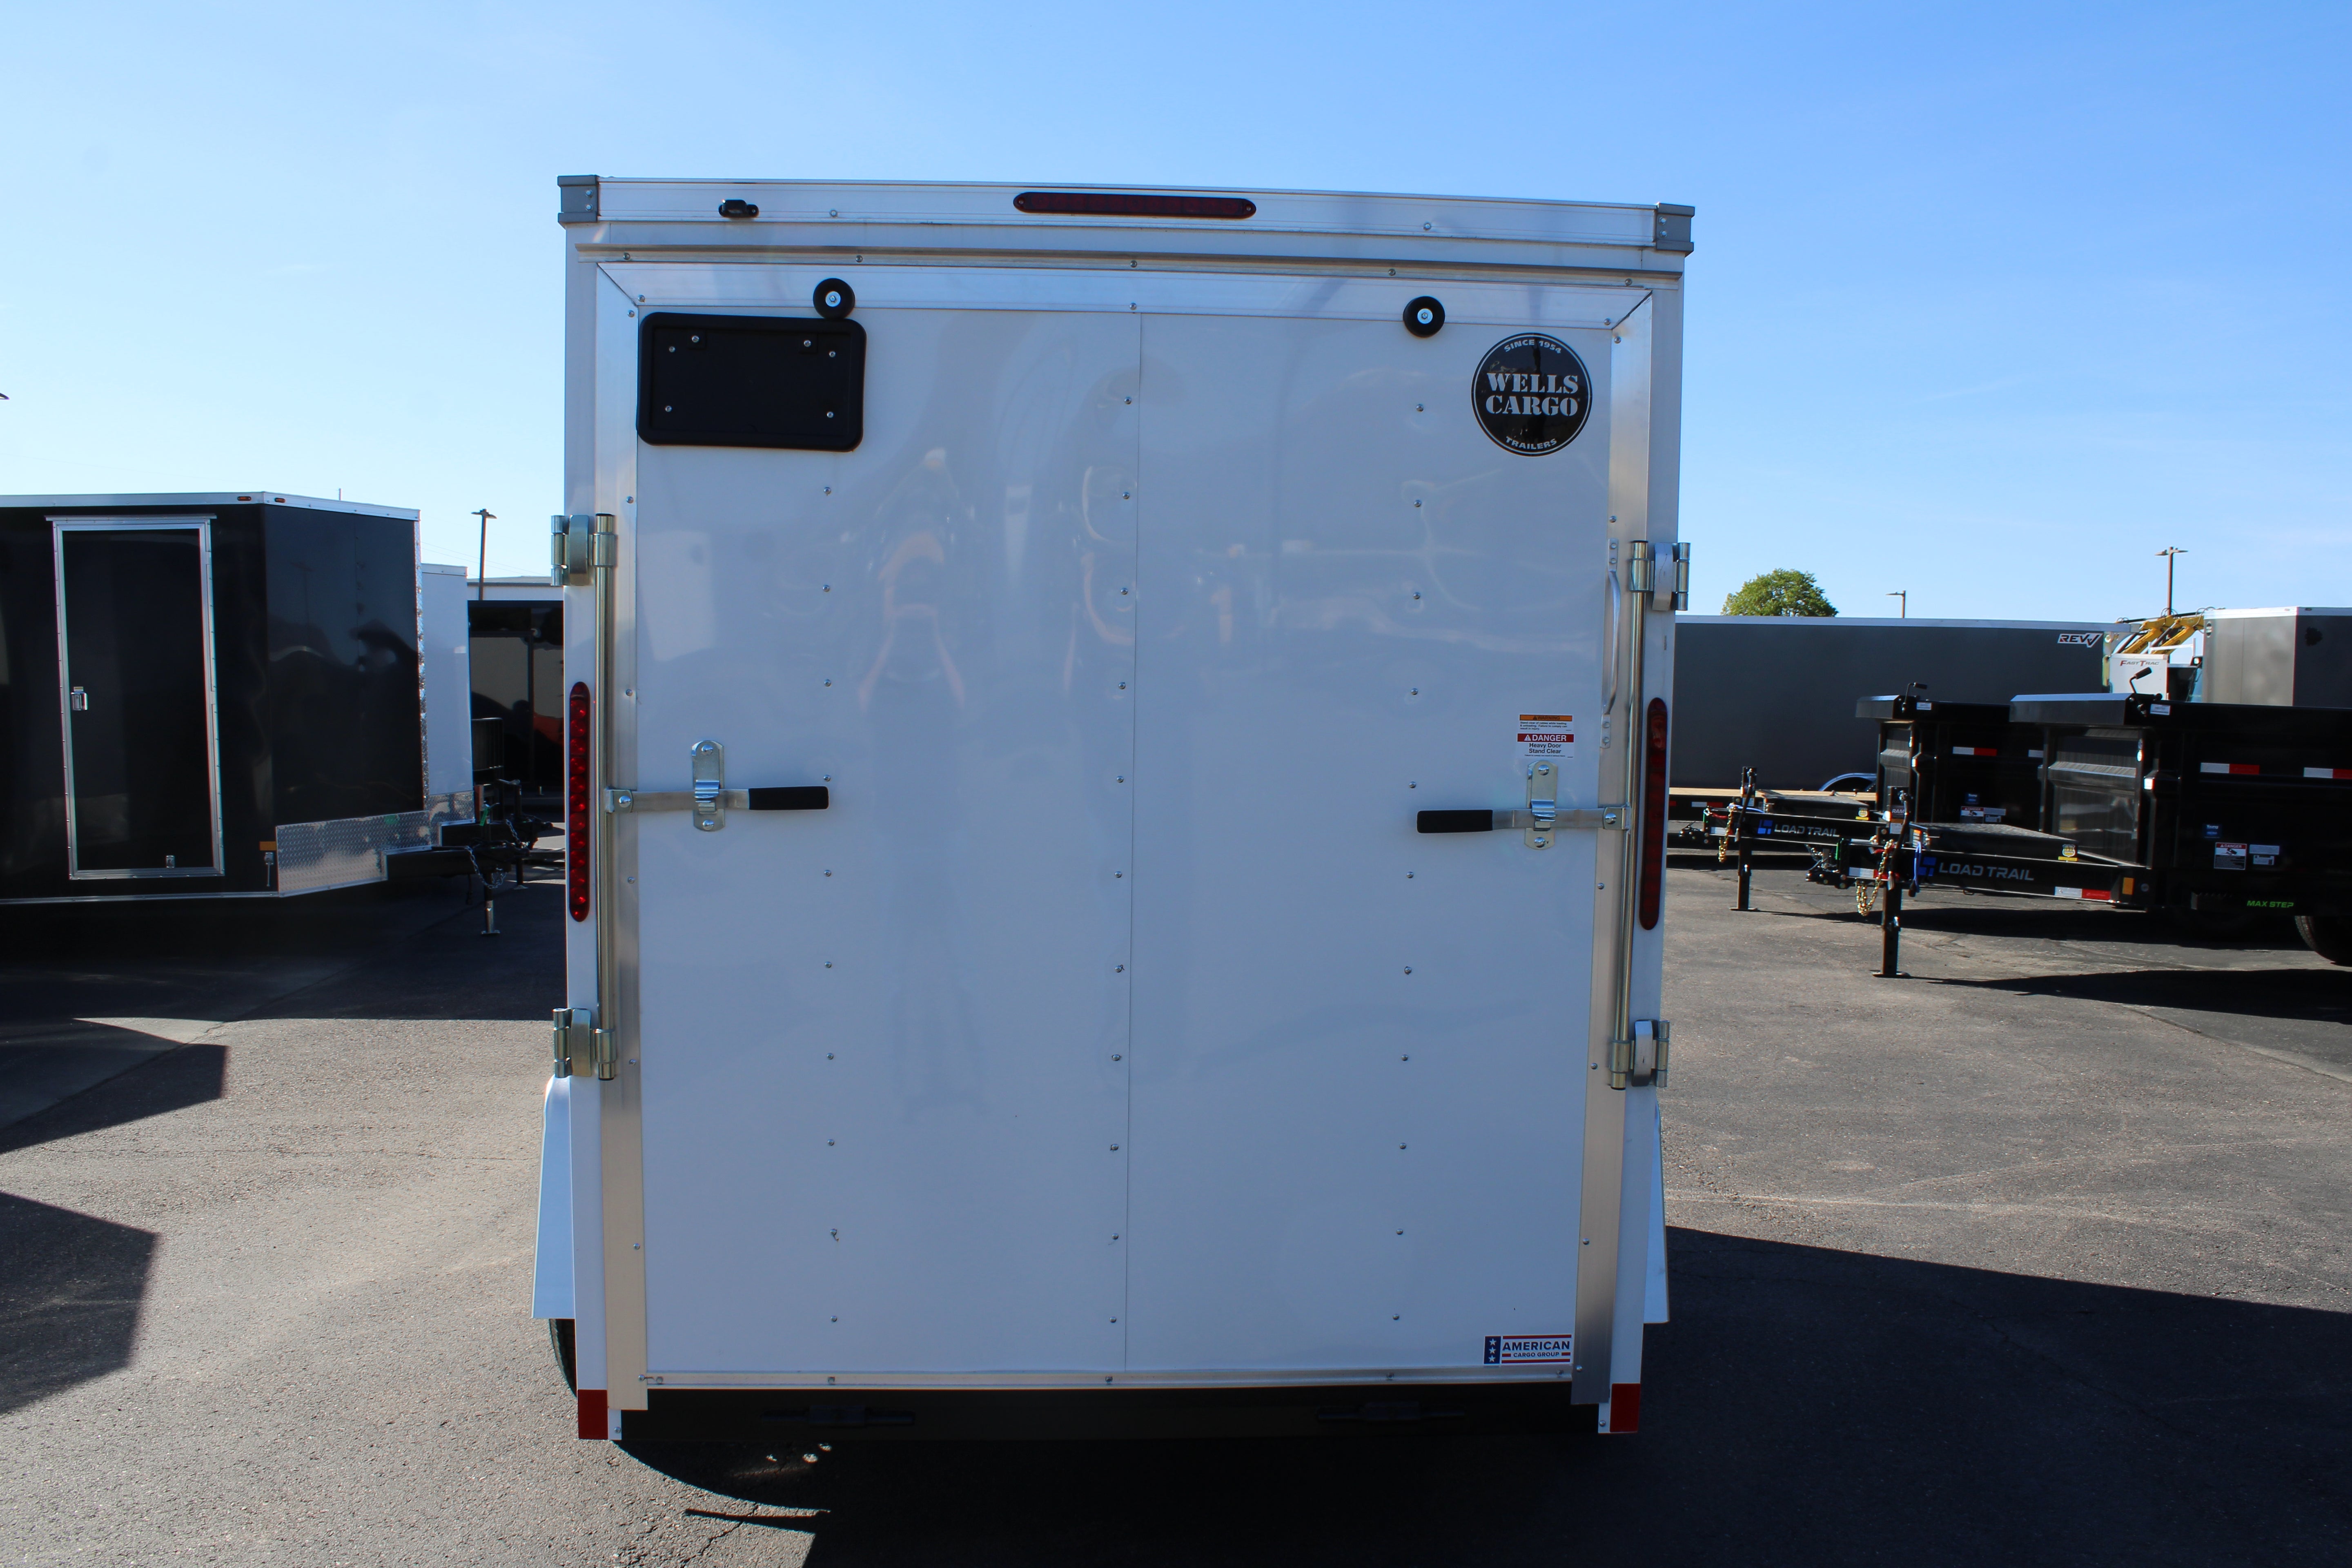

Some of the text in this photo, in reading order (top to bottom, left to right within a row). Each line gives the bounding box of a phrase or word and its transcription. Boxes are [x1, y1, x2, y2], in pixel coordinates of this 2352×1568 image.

[1504, 339, 1562, 354] SINCE 1954
[1486, 372, 1578, 394] WELLS
[1486, 395, 1578, 416] CARGO
[1506, 436, 1557, 449] TRAILERS
[1774, 824, 1840, 837] LOAD TRAIL
[1939, 862, 2034, 881] LOAD TRAIL
[1502, 1341, 1570, 1351] AMERICAN
